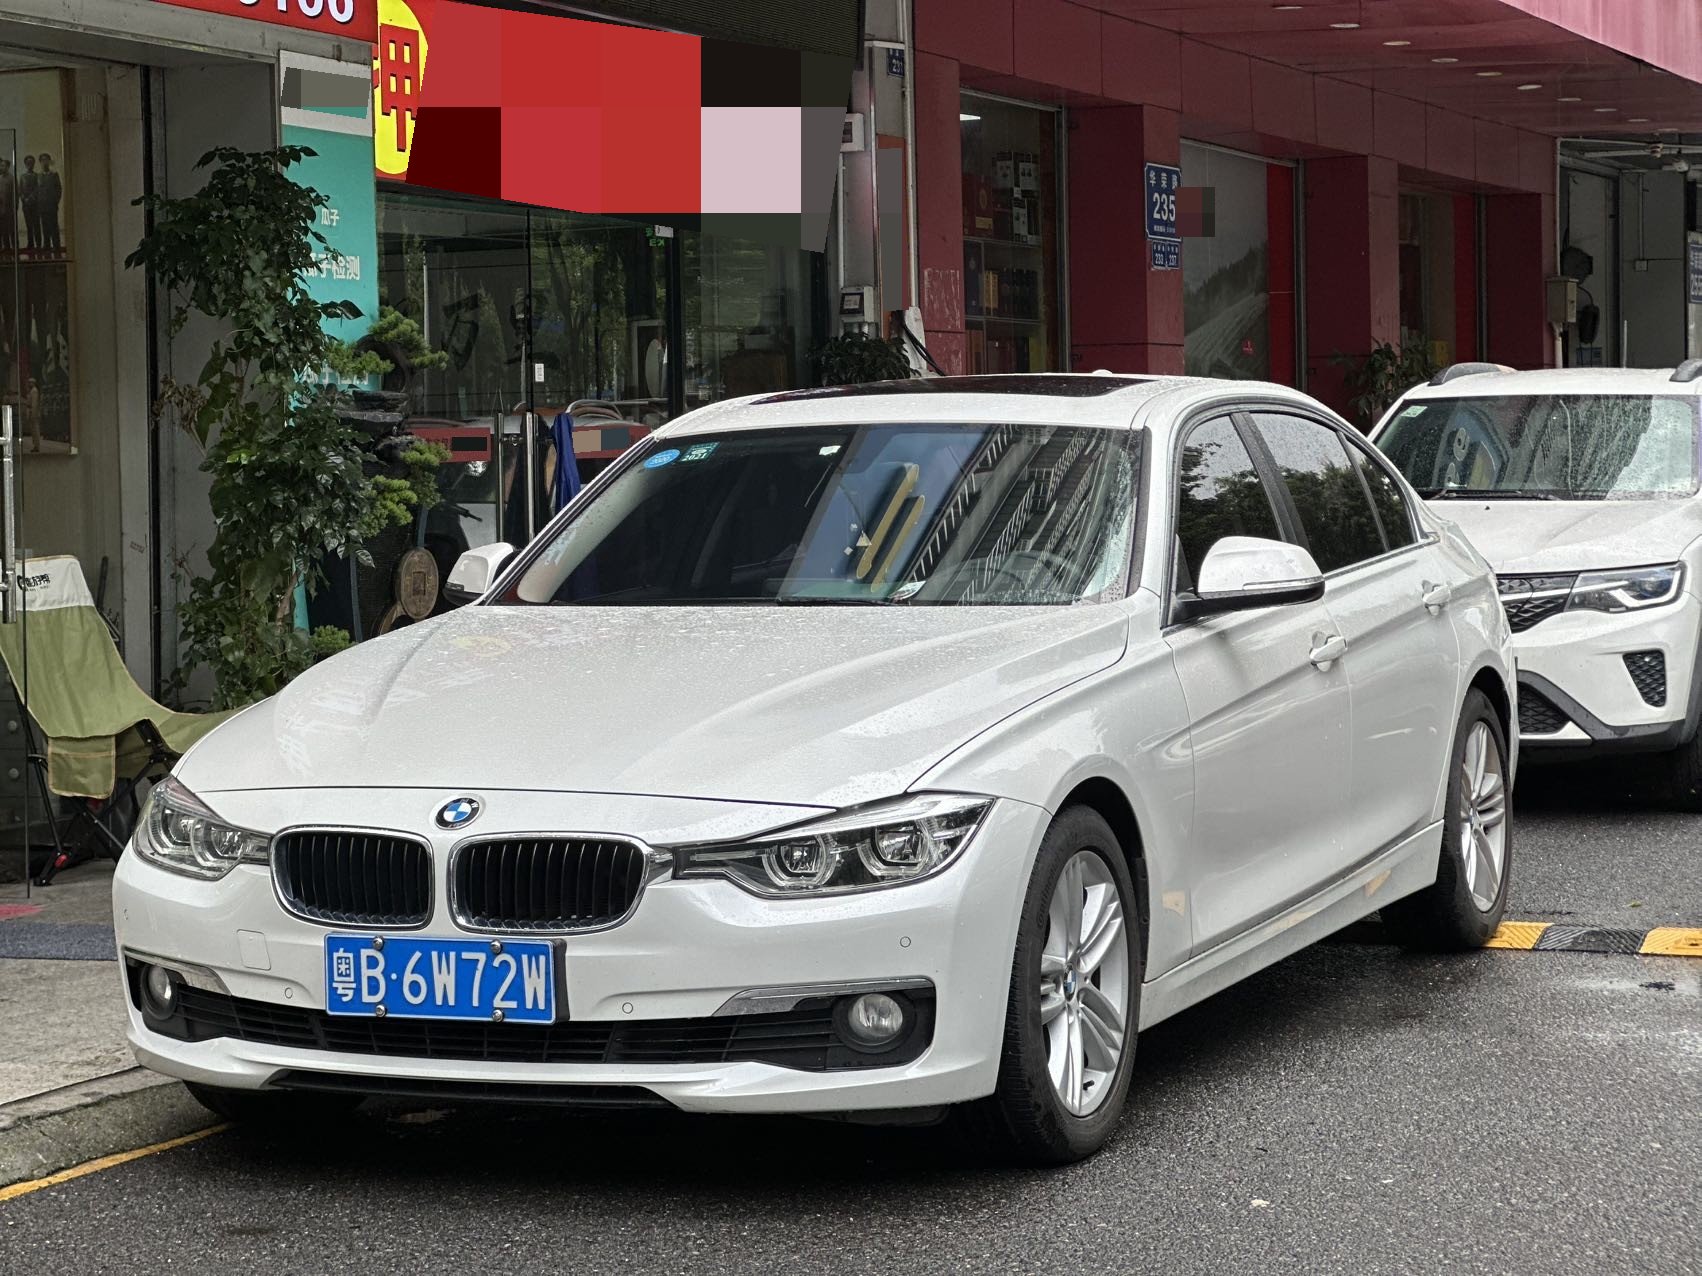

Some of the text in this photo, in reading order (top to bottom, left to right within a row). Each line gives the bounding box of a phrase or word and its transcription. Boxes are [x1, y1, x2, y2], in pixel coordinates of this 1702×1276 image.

[321, 208, 340, 227] 瓜子
[1153, 192, 1176, 222] 235
[332, 947, 547, 1010] 粤B·6W72W
